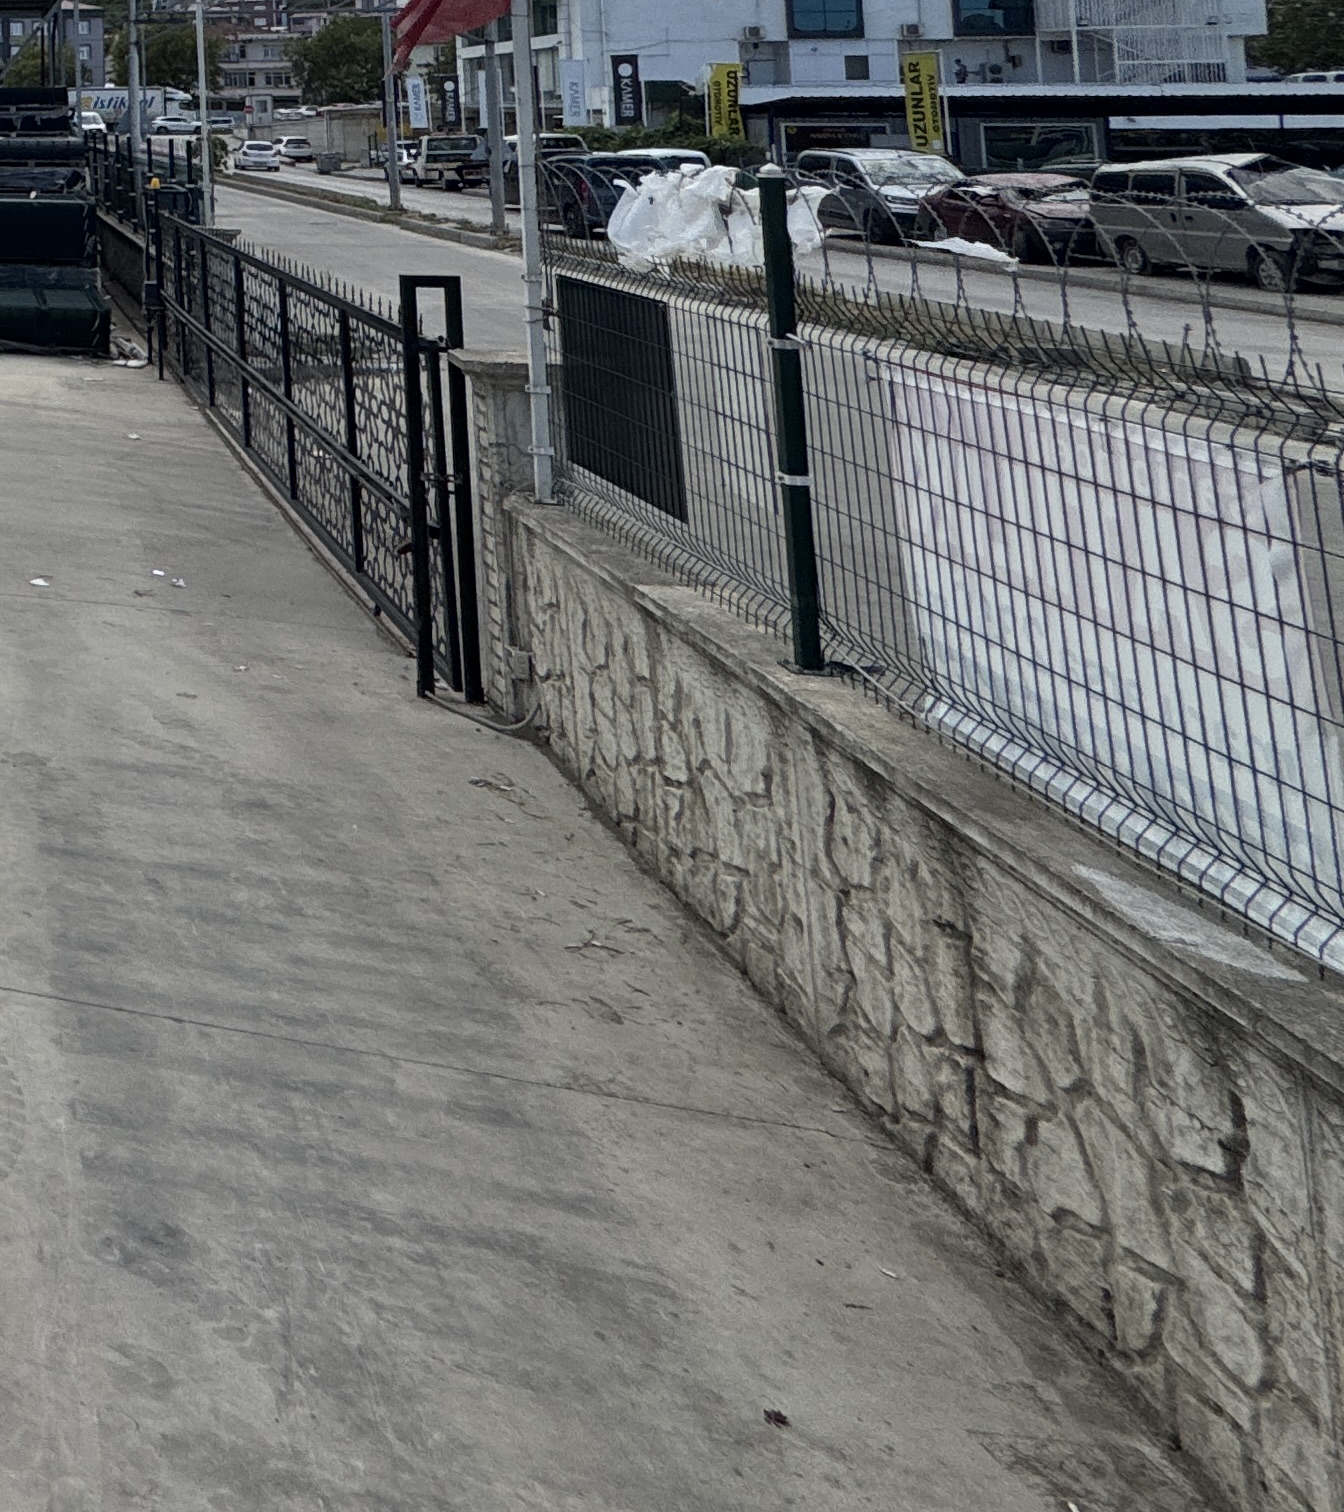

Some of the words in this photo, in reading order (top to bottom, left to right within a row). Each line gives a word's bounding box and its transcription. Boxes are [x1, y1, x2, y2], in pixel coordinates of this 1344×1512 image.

[568, 81, 580, 117] KAMER
[621, 78, 635, 117] KAMER
[908, 61, 928, 147] UZUNLAR
